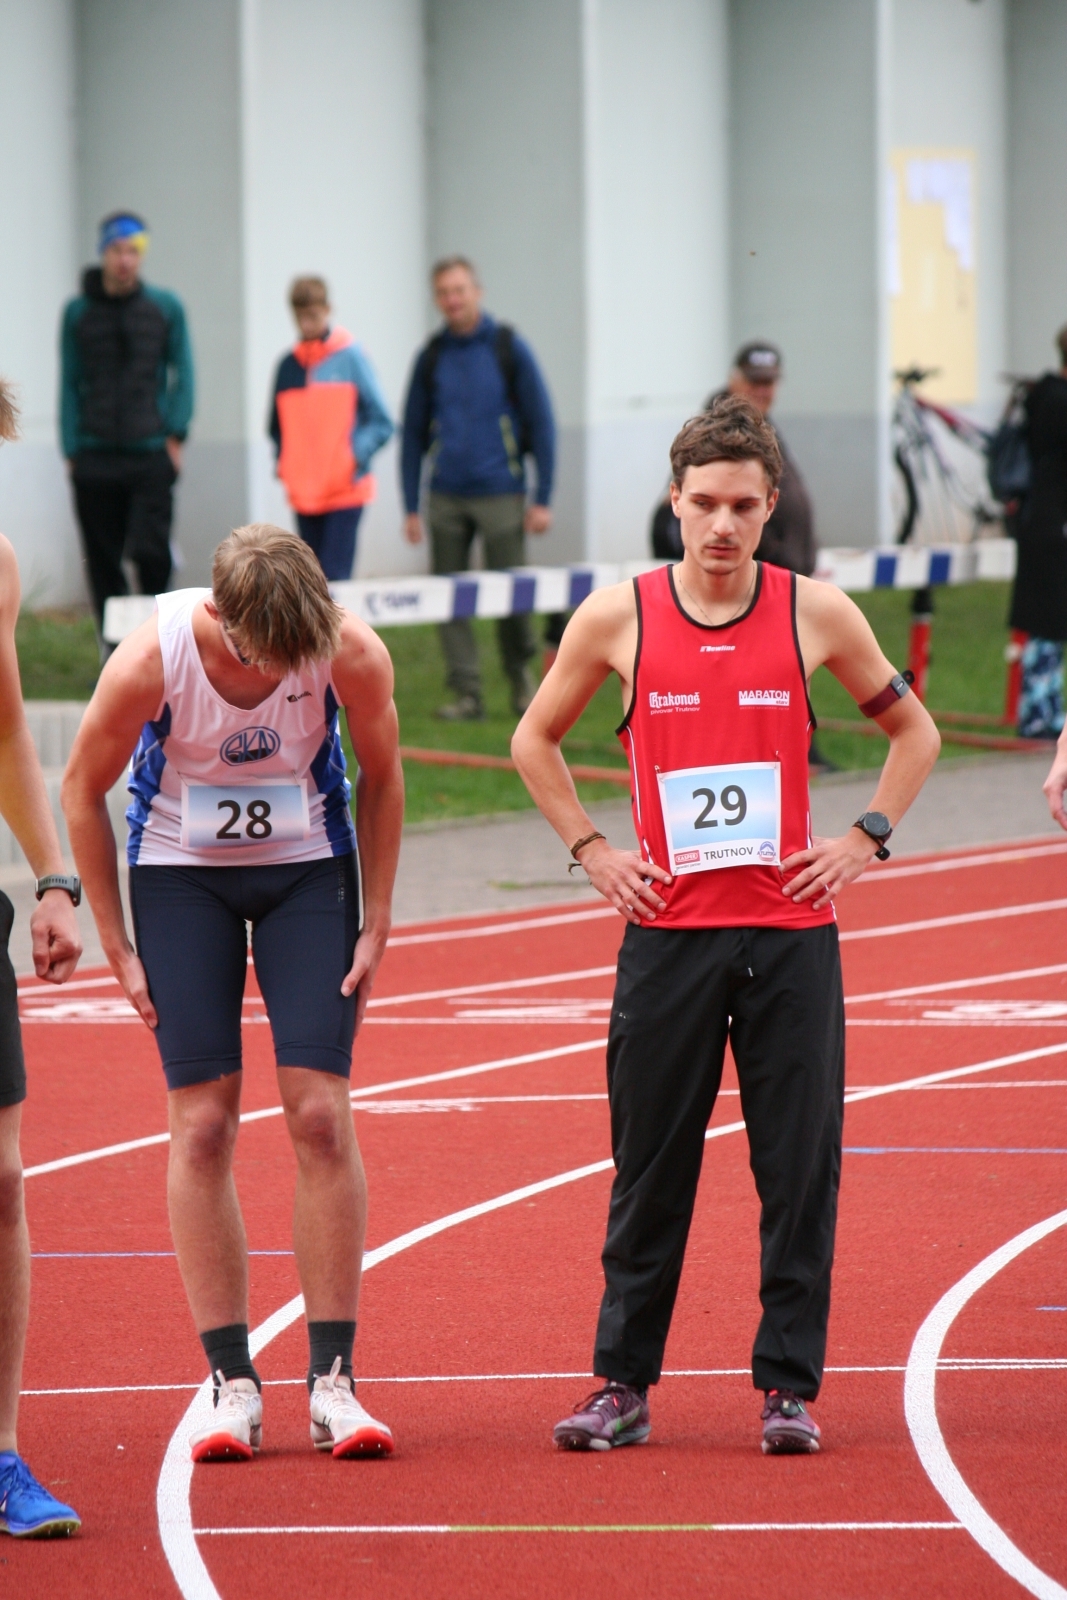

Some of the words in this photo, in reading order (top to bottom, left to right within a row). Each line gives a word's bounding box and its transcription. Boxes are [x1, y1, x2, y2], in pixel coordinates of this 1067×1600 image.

[649, 691, 700, 709] Krakonoš
[738, 689, 790, 700] MARATON
[692, 784, 748, 830] 29
[216, 799, 272, 840] 28
[703, 846, 754, 861] TRUTNOV
